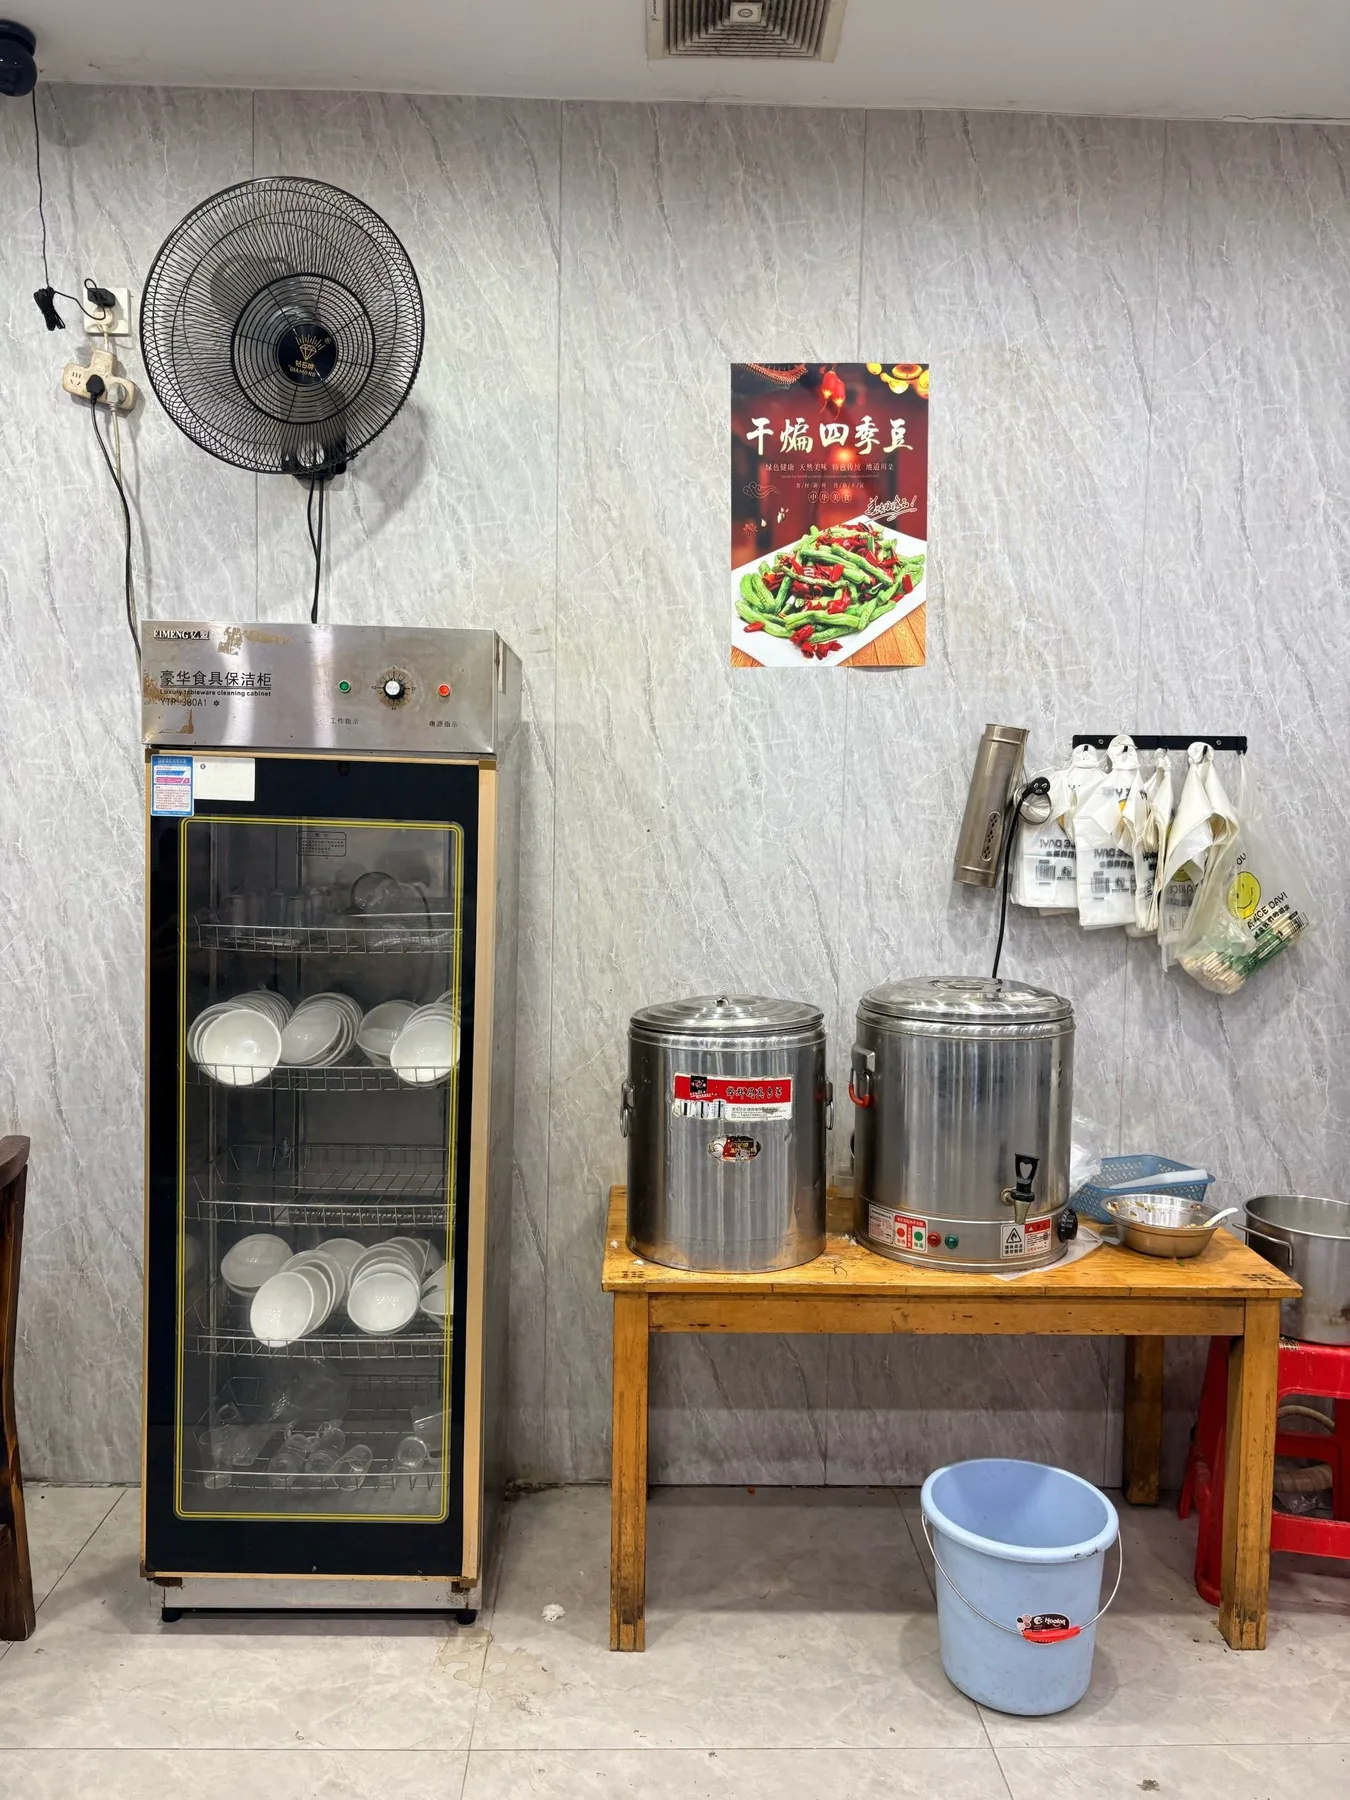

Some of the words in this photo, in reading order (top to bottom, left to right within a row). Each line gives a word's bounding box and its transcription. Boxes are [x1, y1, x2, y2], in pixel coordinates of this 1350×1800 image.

[289, 367, 316, 377] DIAMOND
[746, 415, 914, 456] 干煸四季豆
[800, 463, 828, 471] 天然美味
[160, 669, 272, 687] 豪华食具保洁柜
[1268, 891, 1288, 910] DAY!
